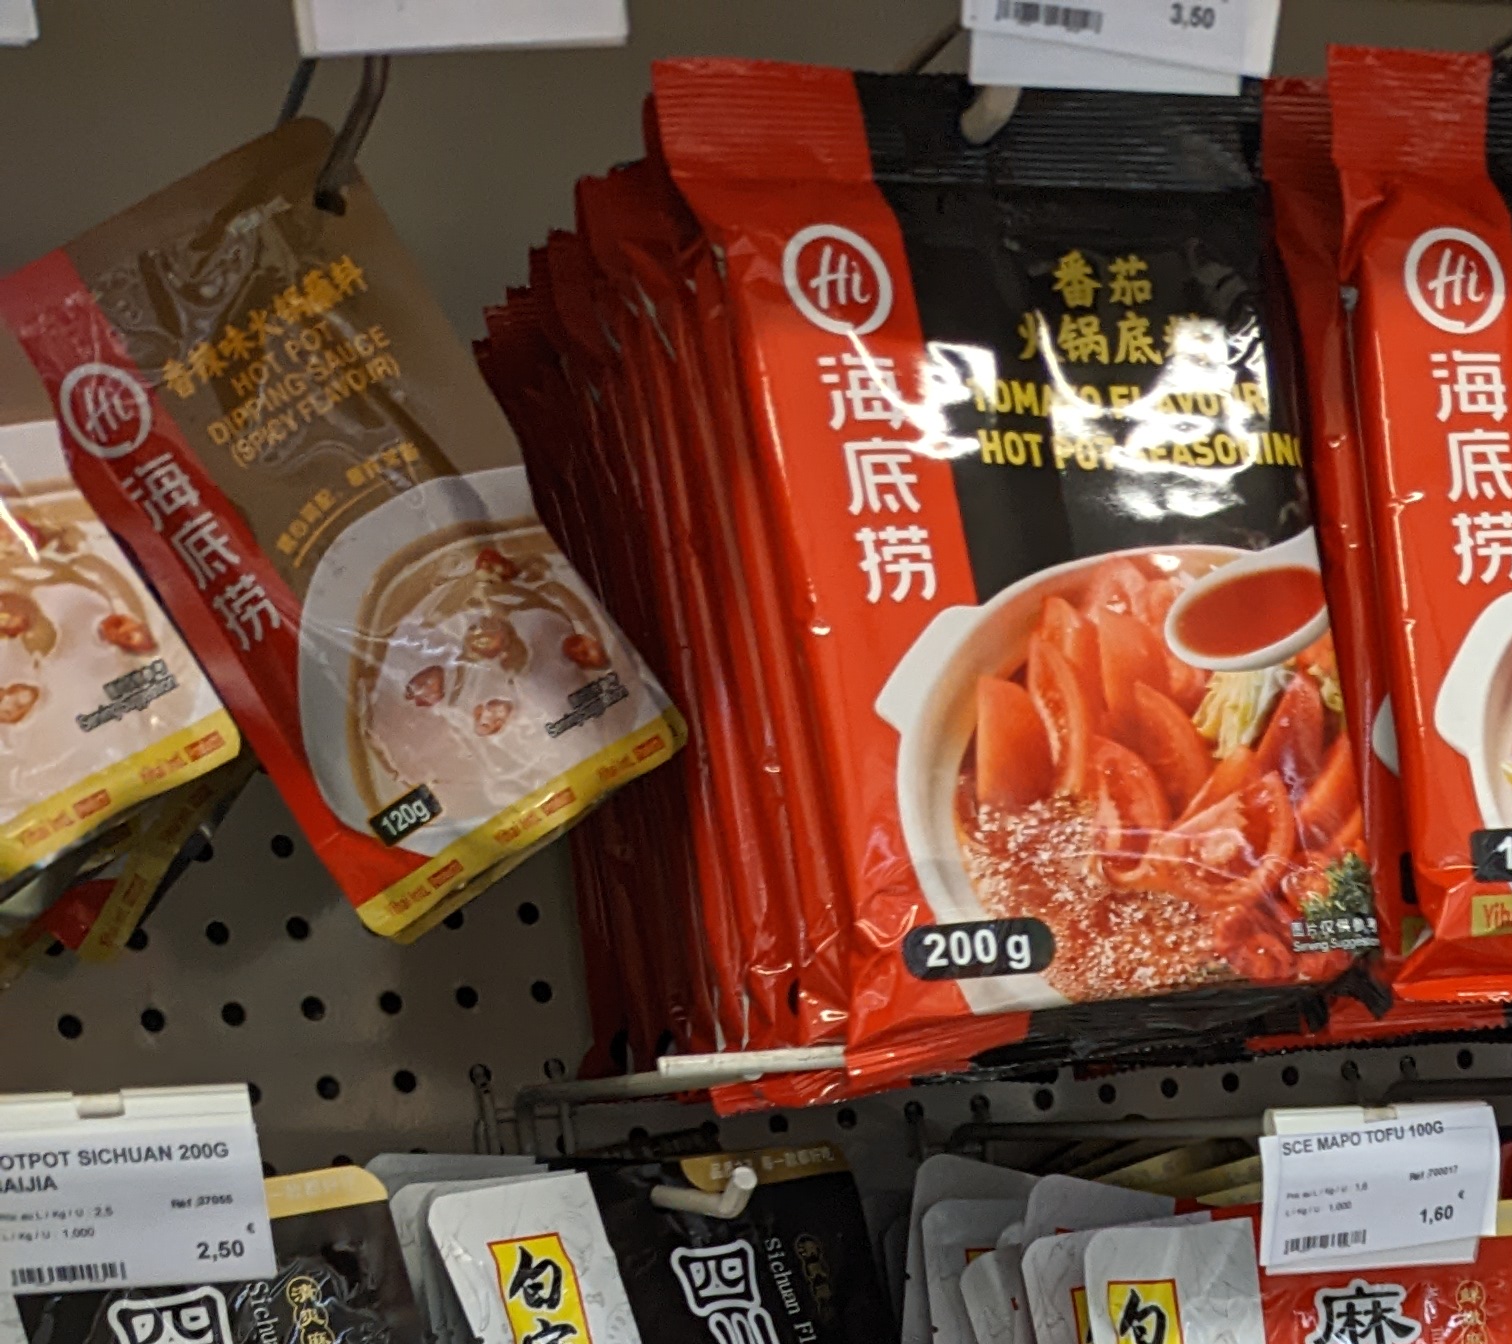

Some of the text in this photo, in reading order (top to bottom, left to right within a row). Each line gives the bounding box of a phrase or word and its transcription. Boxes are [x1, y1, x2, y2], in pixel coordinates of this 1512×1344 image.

[1051, 249, 1154, 308] 番茄
[815, 350, 937, 604] 海底捞
[119, 450, 285, 652] 海底捞
[924, 928, 1033, 976] 200 g
[1282, 1120, 1445, 1157] SCE MAPO TOFU 100G
[1419, 1204, 1454, 1225] 1,60
[196, 1239, 246, 1262] 2,50
